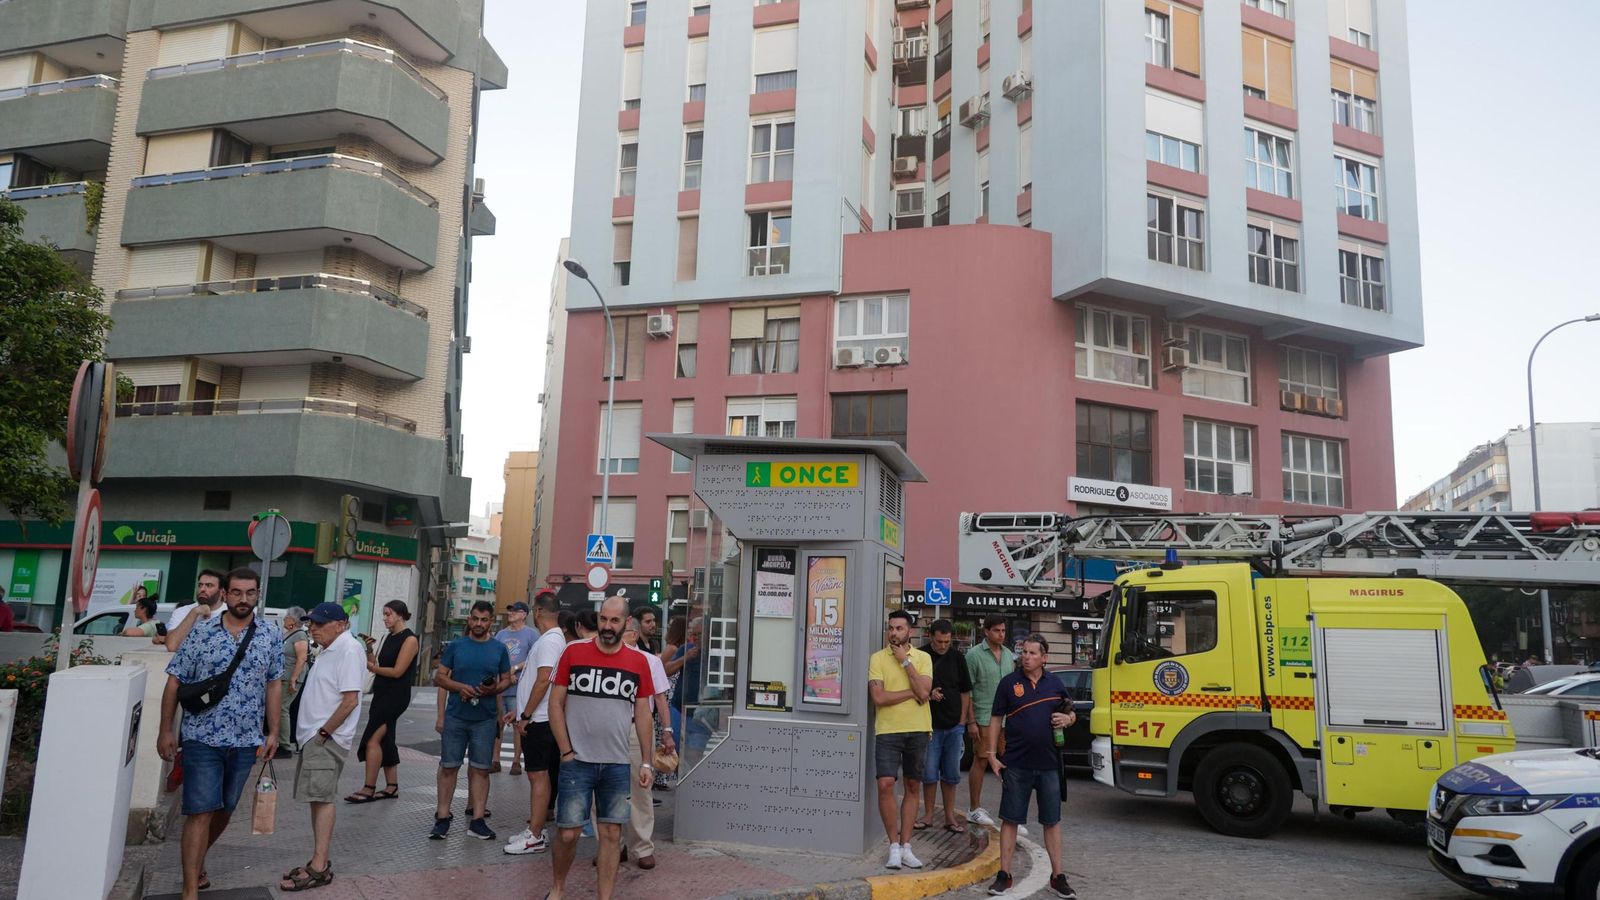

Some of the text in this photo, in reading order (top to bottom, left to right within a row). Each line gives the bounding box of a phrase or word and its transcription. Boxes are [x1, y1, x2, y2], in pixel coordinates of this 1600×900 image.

[779, 466, 849, 484] ONCE
[1074, 485, 1168, 502] RODRIGUEZ & ASOCIADOS
[136, 529, 177, 545] Unicaja
[356, 541, 389, 556] Unicaja
[992, 540, 1016, 579] MAGIRUS
[967, 596, 1057, 608] ALIMENTACIÓN
[814, 598, 839, 626] 15
[809, 627, 842, 636] MILLONES
[1264, 595, 1275, 677] www.cbpc.es
[1281, 636, 1309, 646] 112
[1115, 720, 1165, 738] E-17
